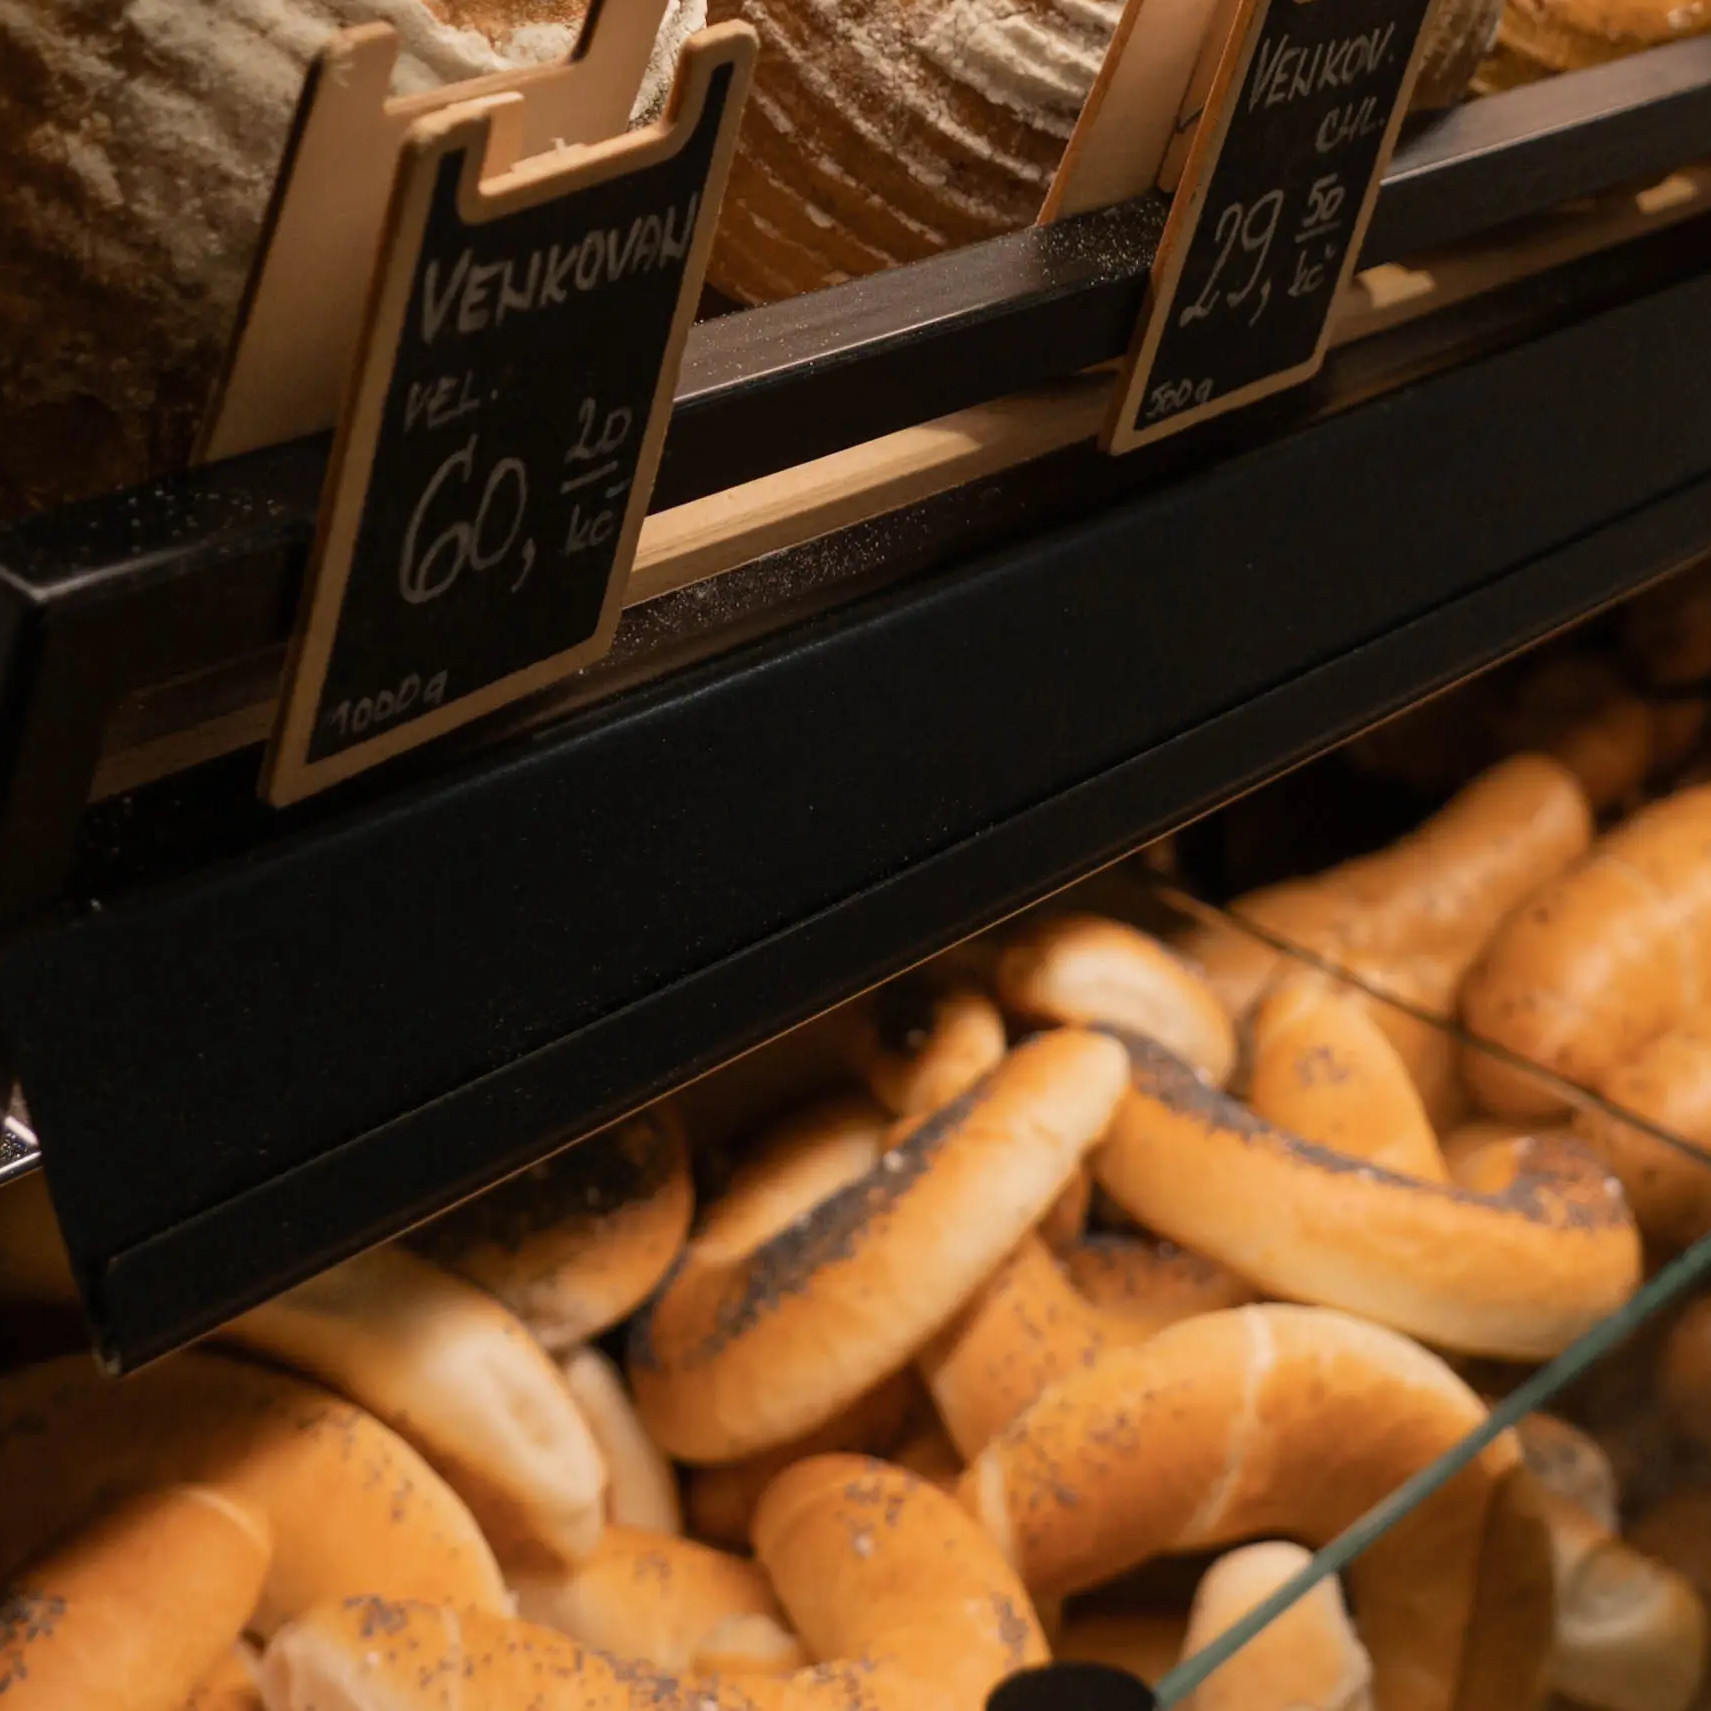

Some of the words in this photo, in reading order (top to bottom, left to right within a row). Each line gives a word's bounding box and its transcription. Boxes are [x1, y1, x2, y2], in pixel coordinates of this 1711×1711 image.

[1302, 173, 1346, 228] 50
[421, 191, 698, 345] VENKOVAN
[565, 397, 632, 464] 20
